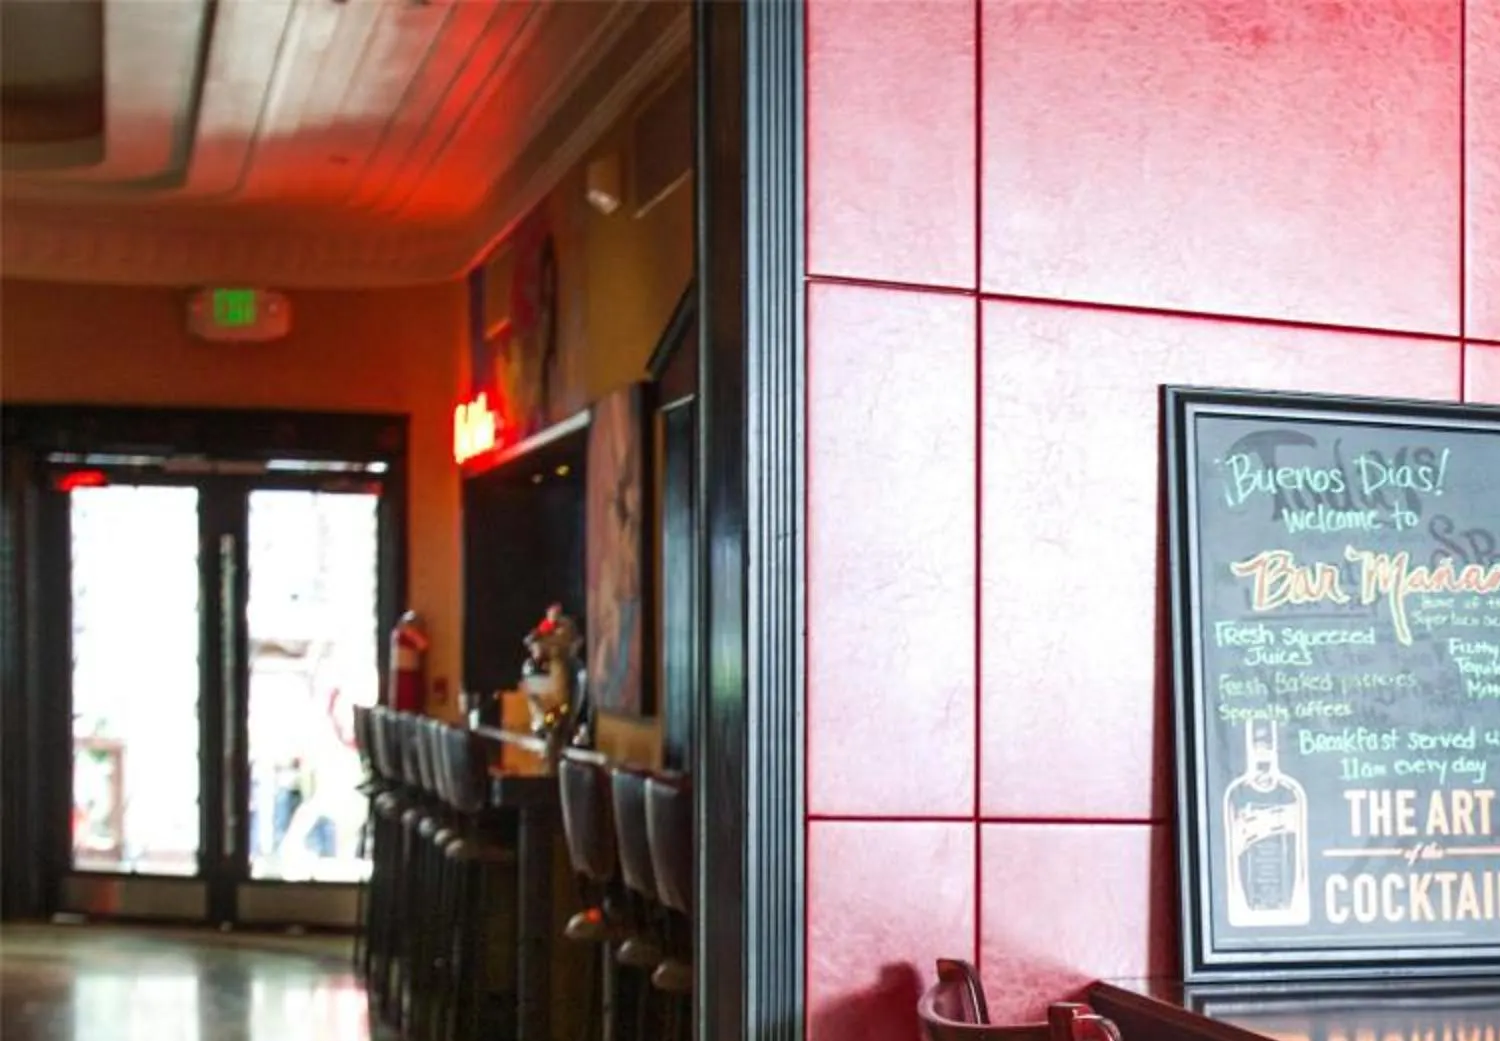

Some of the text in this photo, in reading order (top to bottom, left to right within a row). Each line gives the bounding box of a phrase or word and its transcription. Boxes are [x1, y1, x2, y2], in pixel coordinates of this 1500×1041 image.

[1393, 501, 1419, 532] to
[1230, 549, 1351, 611] Bar
[1244, 644, 1313, 666] Juices
[1407, 725, 1476, 750] served
[1338, 756, 1488, 785] 11am every day
[1344, 788, 1418, 837] THE
[1425, 788, 1496, 837] ART
